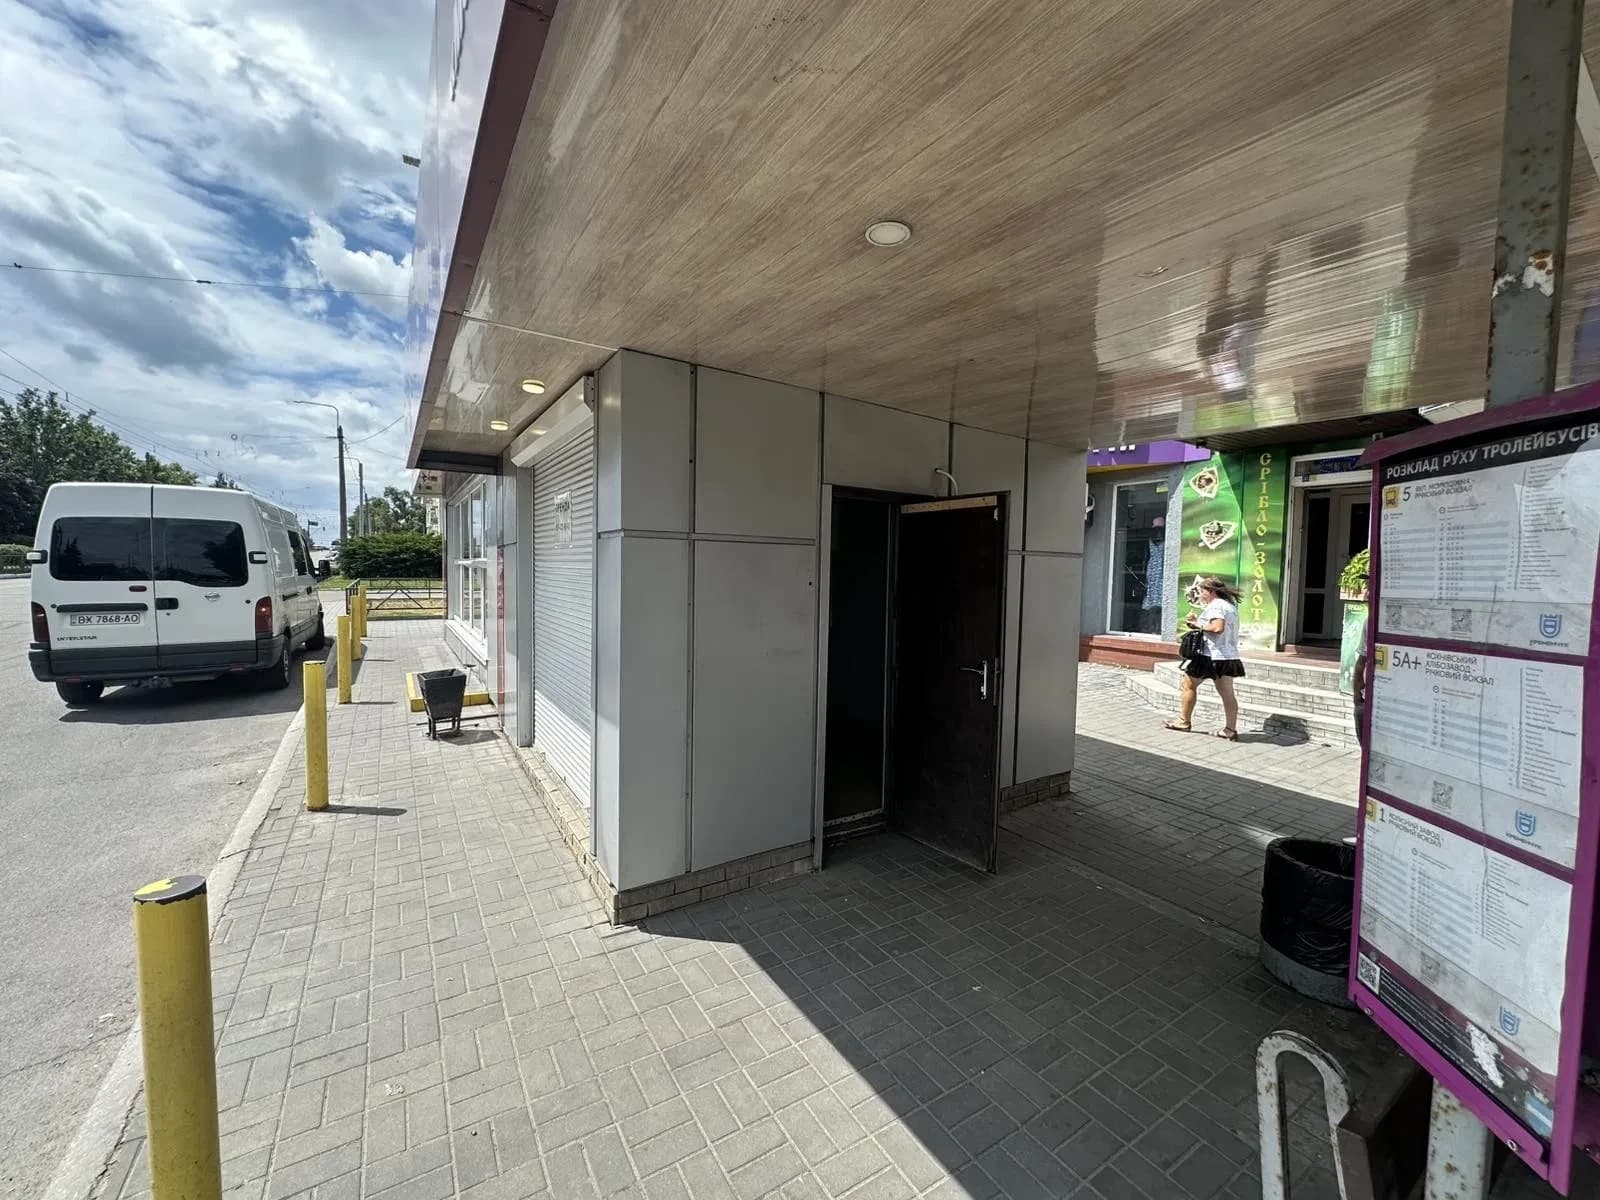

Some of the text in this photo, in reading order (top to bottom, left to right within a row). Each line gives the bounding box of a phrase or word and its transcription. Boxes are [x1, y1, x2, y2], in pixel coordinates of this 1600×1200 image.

[1386, 457, 1439, 479] РОЗКЛАД
[1483, 422, 1598, 459] ТРОЛЕЙБУСІВ
[1402, 486, 1411, 501] 5
[1379, 807, 1386, 823] 1
